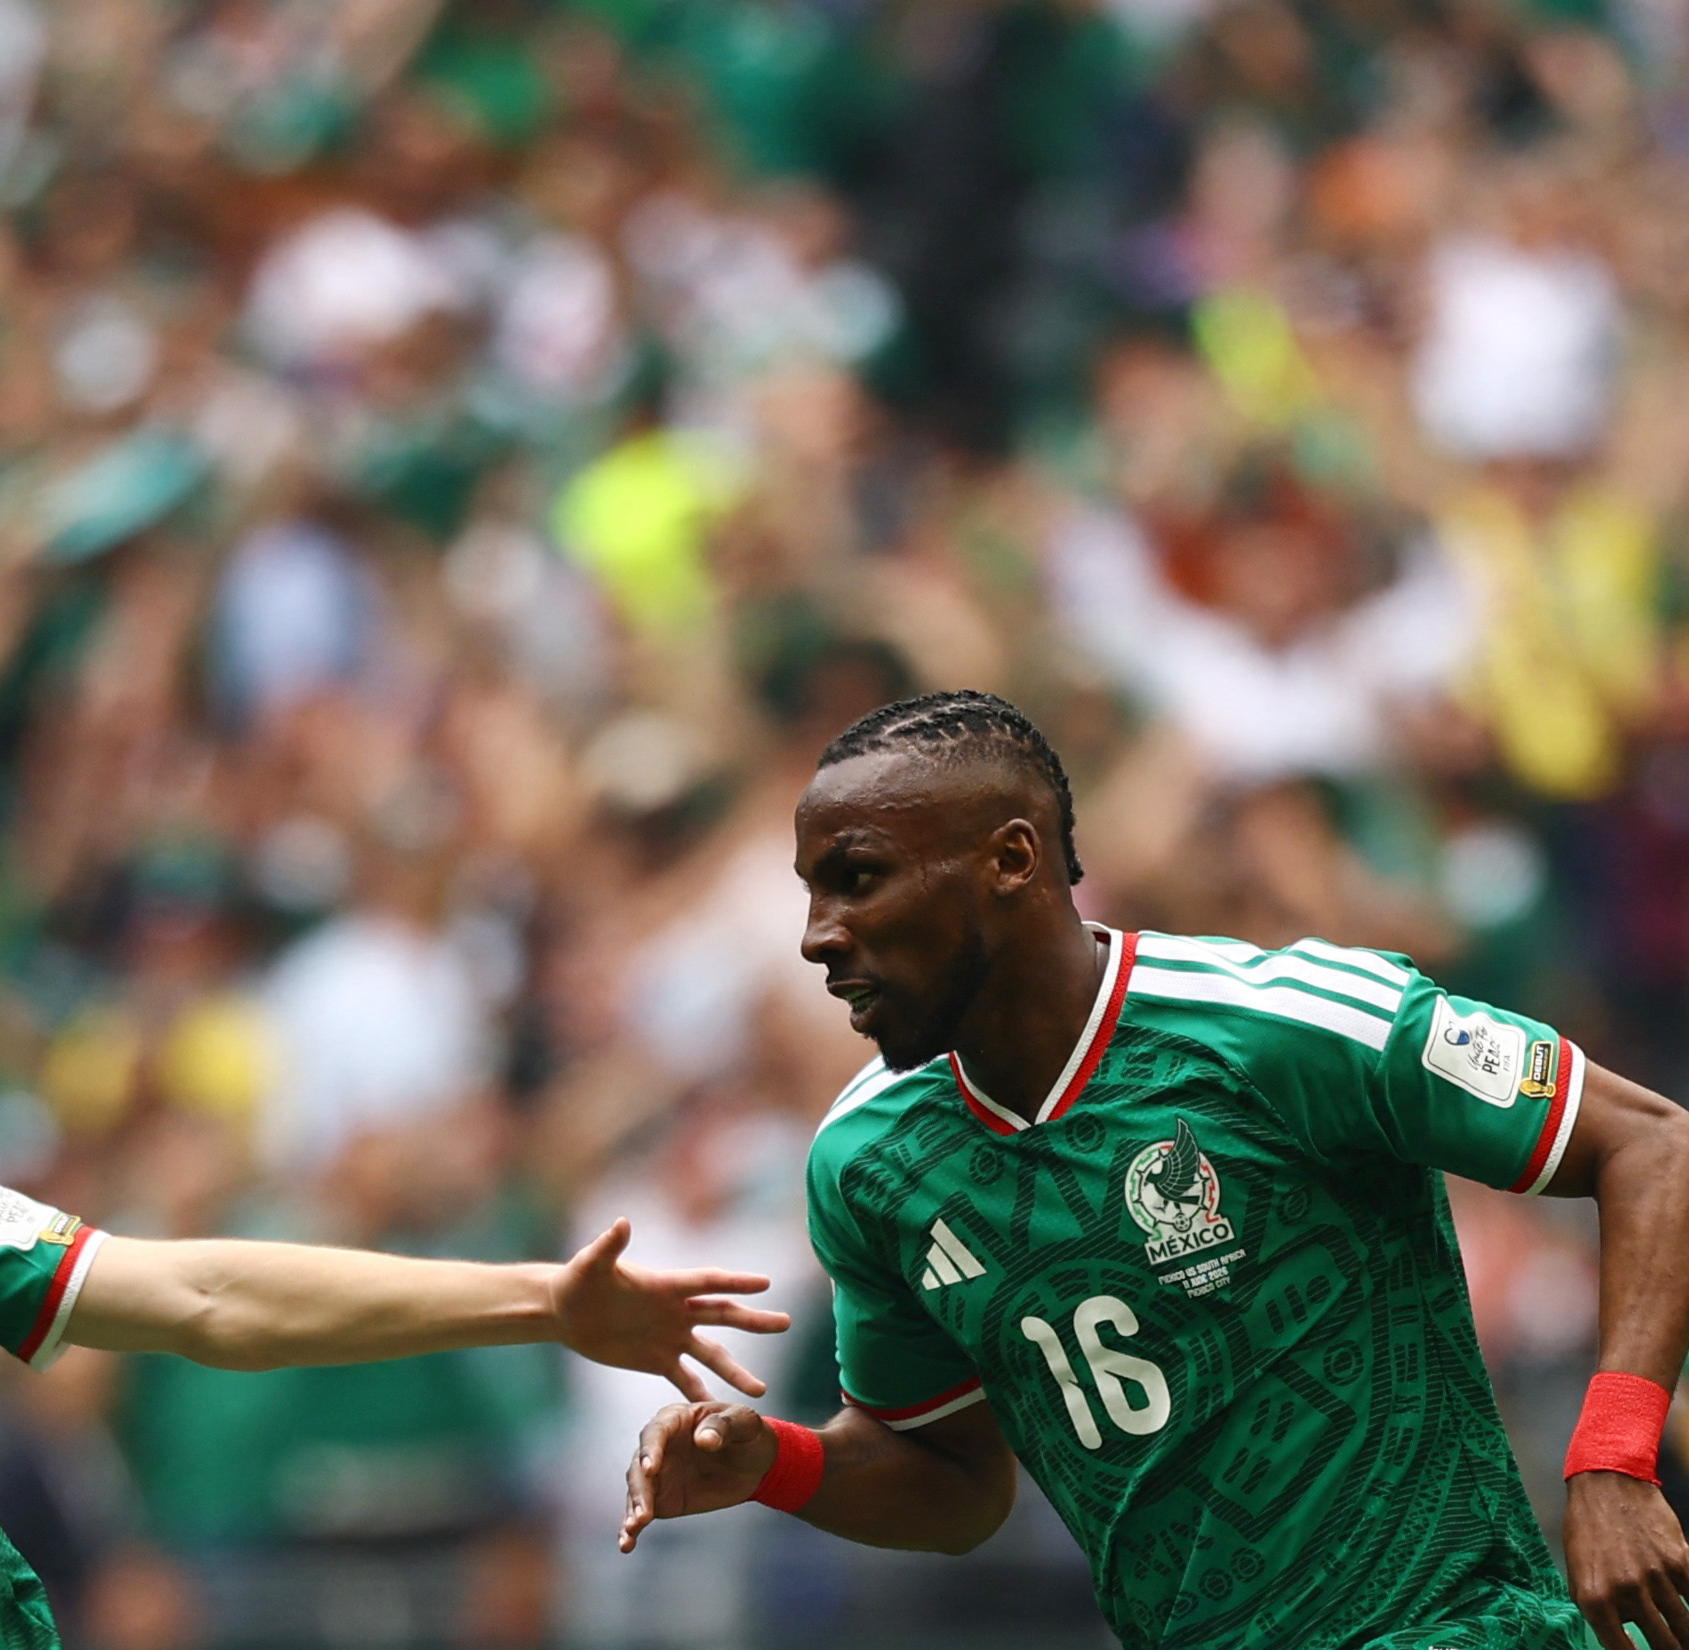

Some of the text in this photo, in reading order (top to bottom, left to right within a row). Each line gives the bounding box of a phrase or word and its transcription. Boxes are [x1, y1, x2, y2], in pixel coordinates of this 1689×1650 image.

[1533, 1044, 1544, 1081] DEBUT
[1148, 1223, 1230, 1262] MÉXICO
[1020, 1294, 1171, 1450] 16
